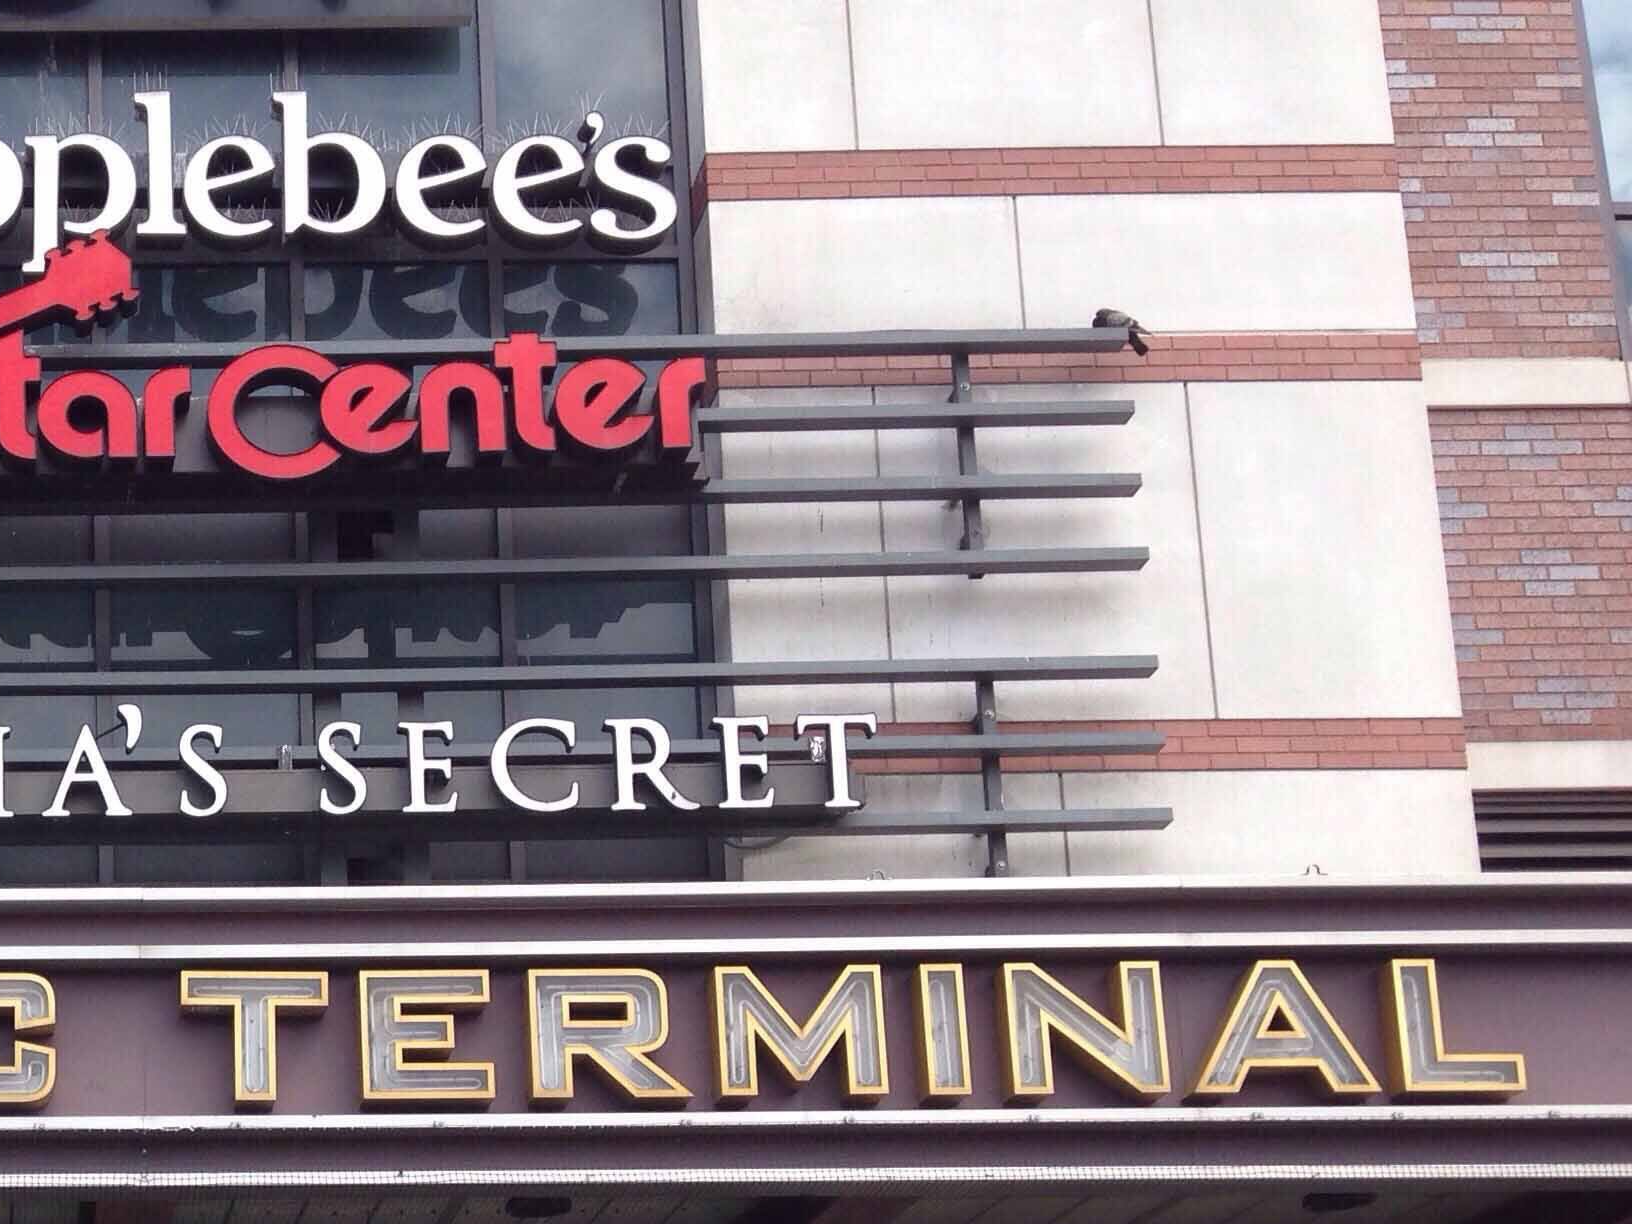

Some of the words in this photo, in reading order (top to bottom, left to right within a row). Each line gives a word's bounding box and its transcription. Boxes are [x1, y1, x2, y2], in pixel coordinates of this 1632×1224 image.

[207, 332, 707, 481] Center
[318, 712, 878, 819] SECRET
[180, 957, 1528, 1110] TERMINAL
